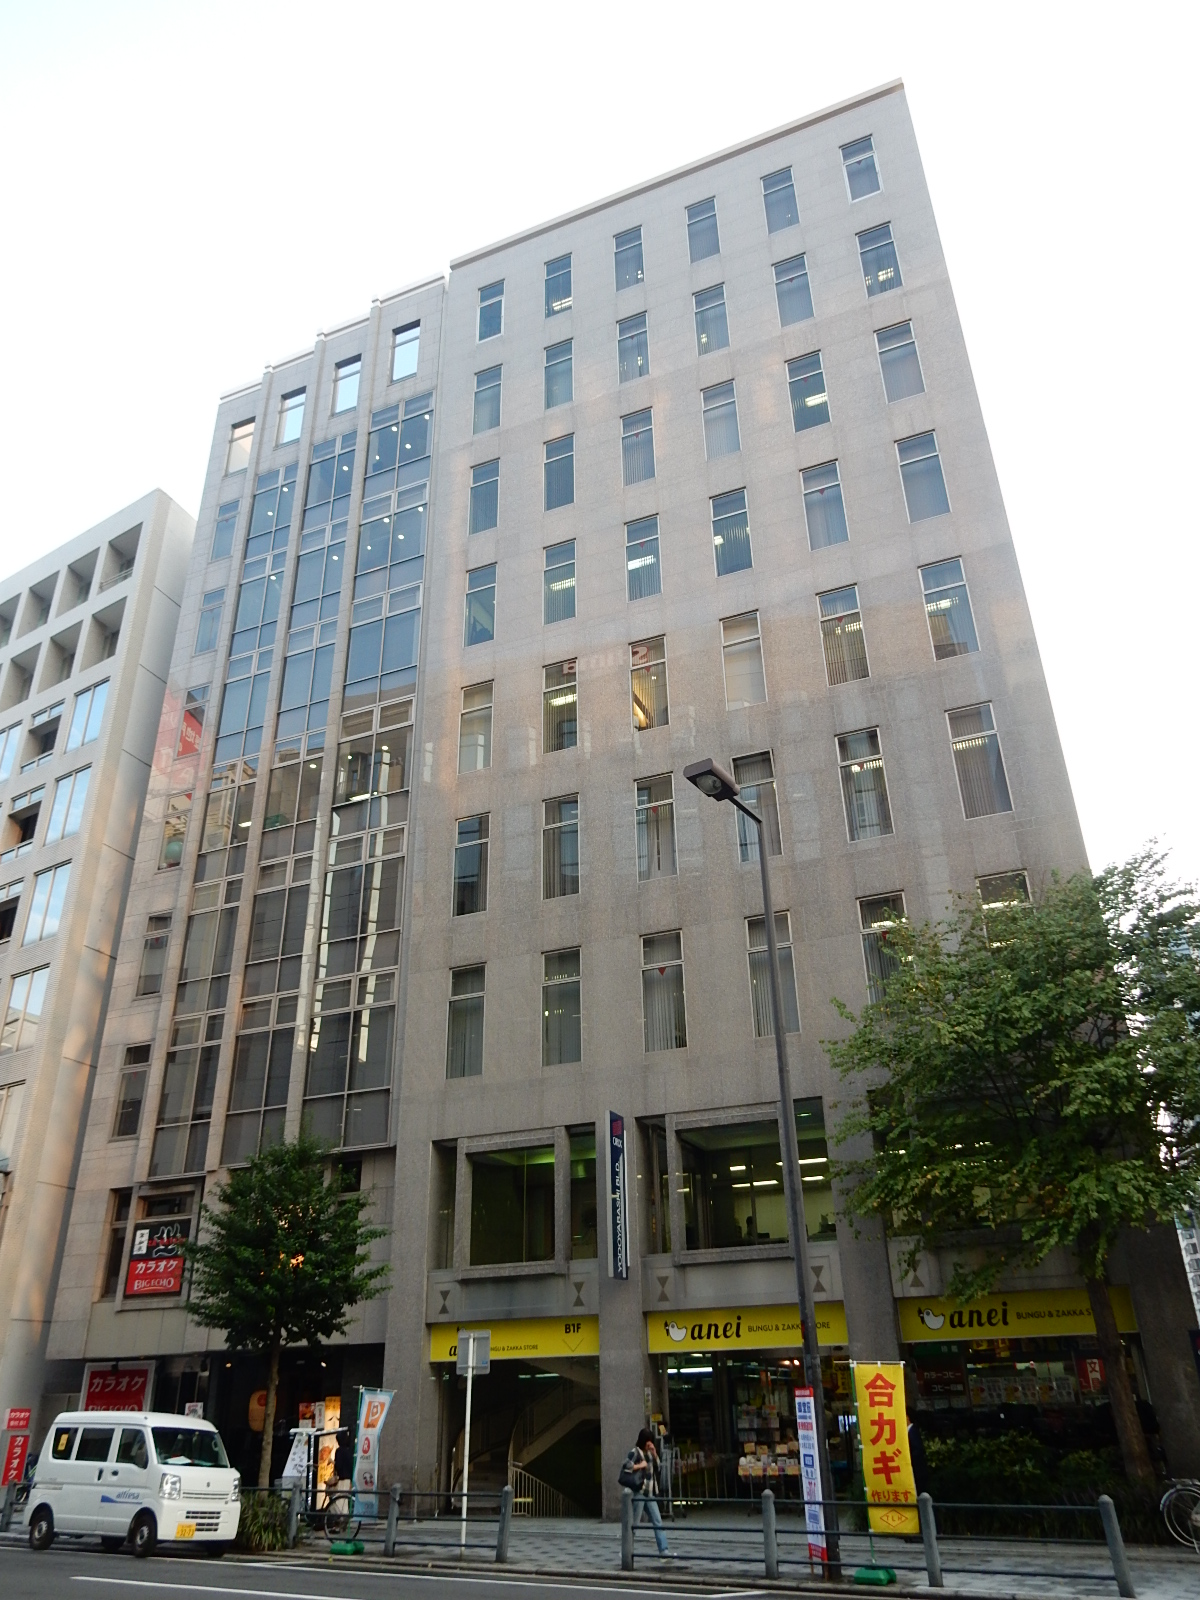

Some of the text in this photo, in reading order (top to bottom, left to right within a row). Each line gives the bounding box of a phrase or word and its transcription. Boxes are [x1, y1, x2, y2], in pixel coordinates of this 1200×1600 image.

[135, 1260, 178, 1274] カラオケ
[134, 1277, 174, 1290] BIG ECHO
[949, 1301, 1009, 1328] anei
[1016, 1311, 1047, 1320] BUNGU
[1055, 1309, 1085, 1318] ZAKKA
[564, 1323, 582, 1334] B1F
[690, 1315, 742, 1340] anei
[747, 1324, 773, 1333] BUNGU
[782, 1323, 801, 1331] ZAKK
[89, 1376, 145, 1393] カラオケ
[864, 1372, 902, 1485] 合カギ
[8, 1436, 24, 1479] カラオケ
[871, 1489, 911, 1503] 作ります
